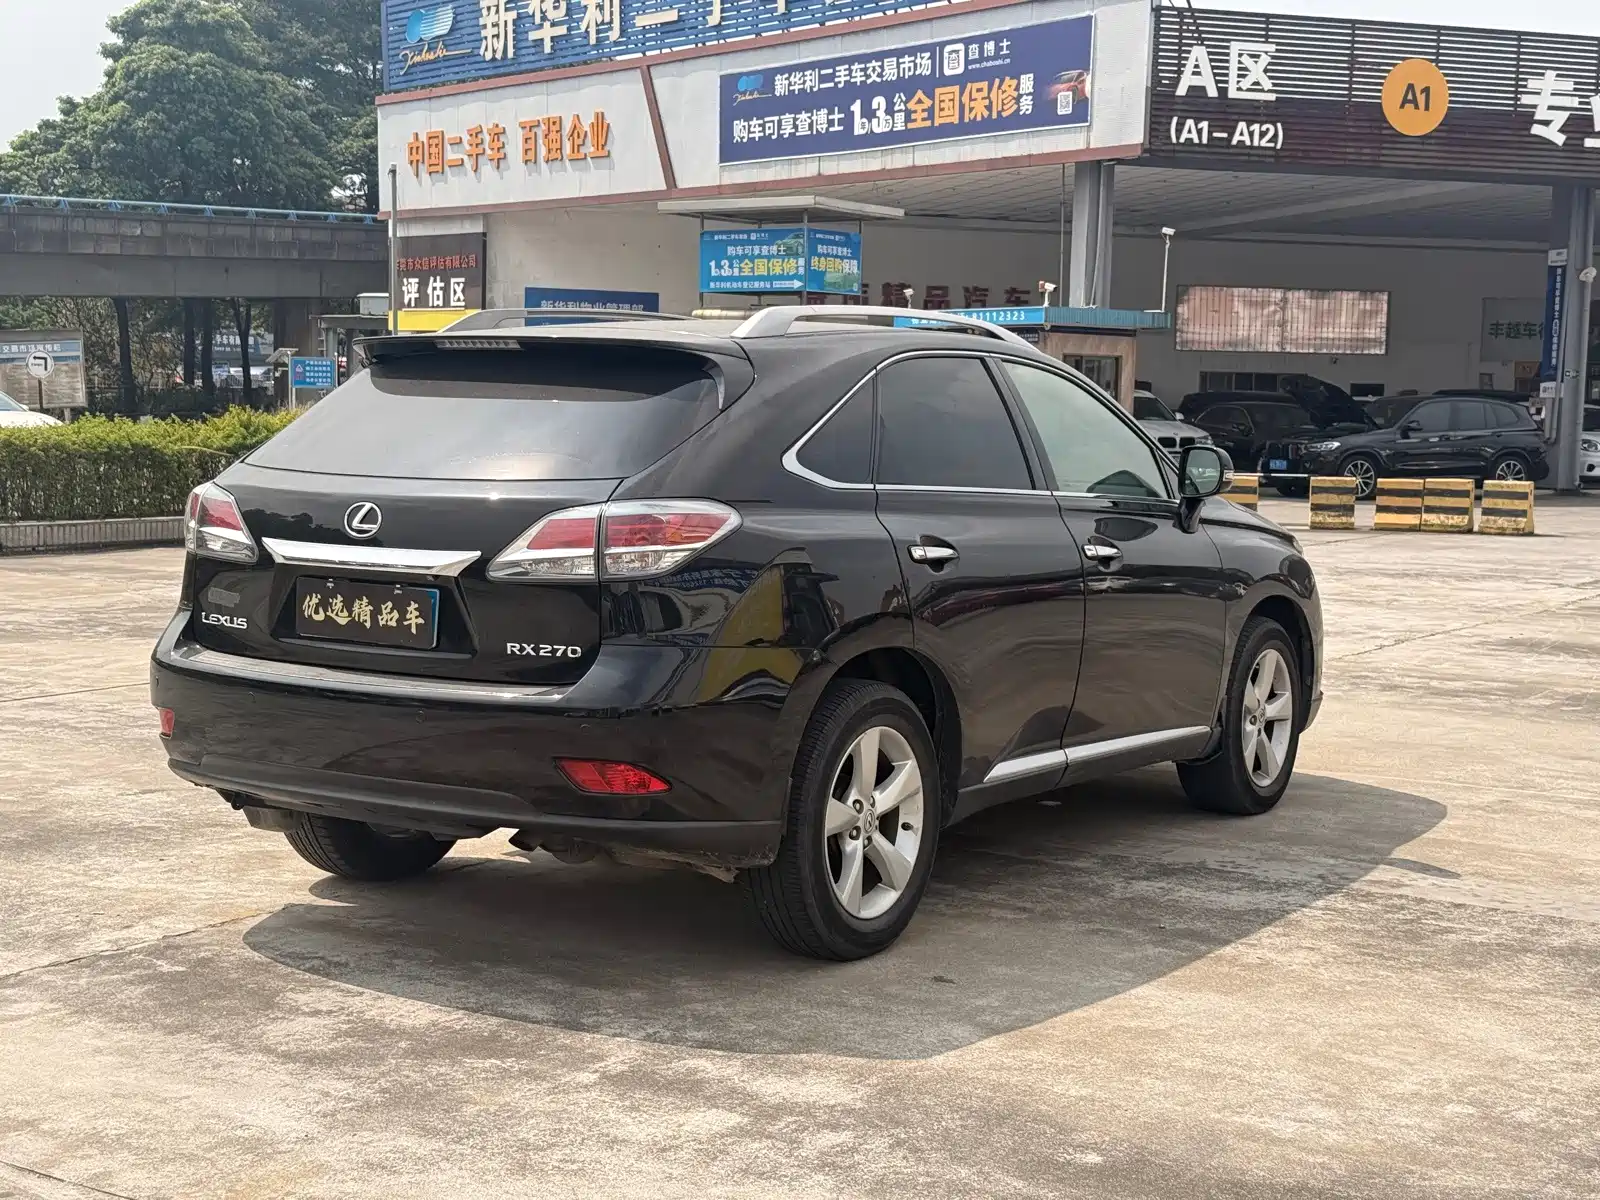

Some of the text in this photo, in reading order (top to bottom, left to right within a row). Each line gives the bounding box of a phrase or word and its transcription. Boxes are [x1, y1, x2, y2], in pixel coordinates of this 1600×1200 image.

[968, 38, 1011, 60] 查博士
[968, 57, 1011, 70] www.chaboshi.cn
[774, 52, 932, 97] 新华利二手车交易市场
[1175, 41, 1277, 101] A区
[1399, 82, 1431, 112] A1
[733, 106, 845, 143] 购车可享查博士
[407, 108, 611, 178] 中国二手车 百强企业
[402, 275, 466, 307] 评估区
[201, 611, 248, 629] LEXUS
[302, 592, 426, 635] 优选精品车
